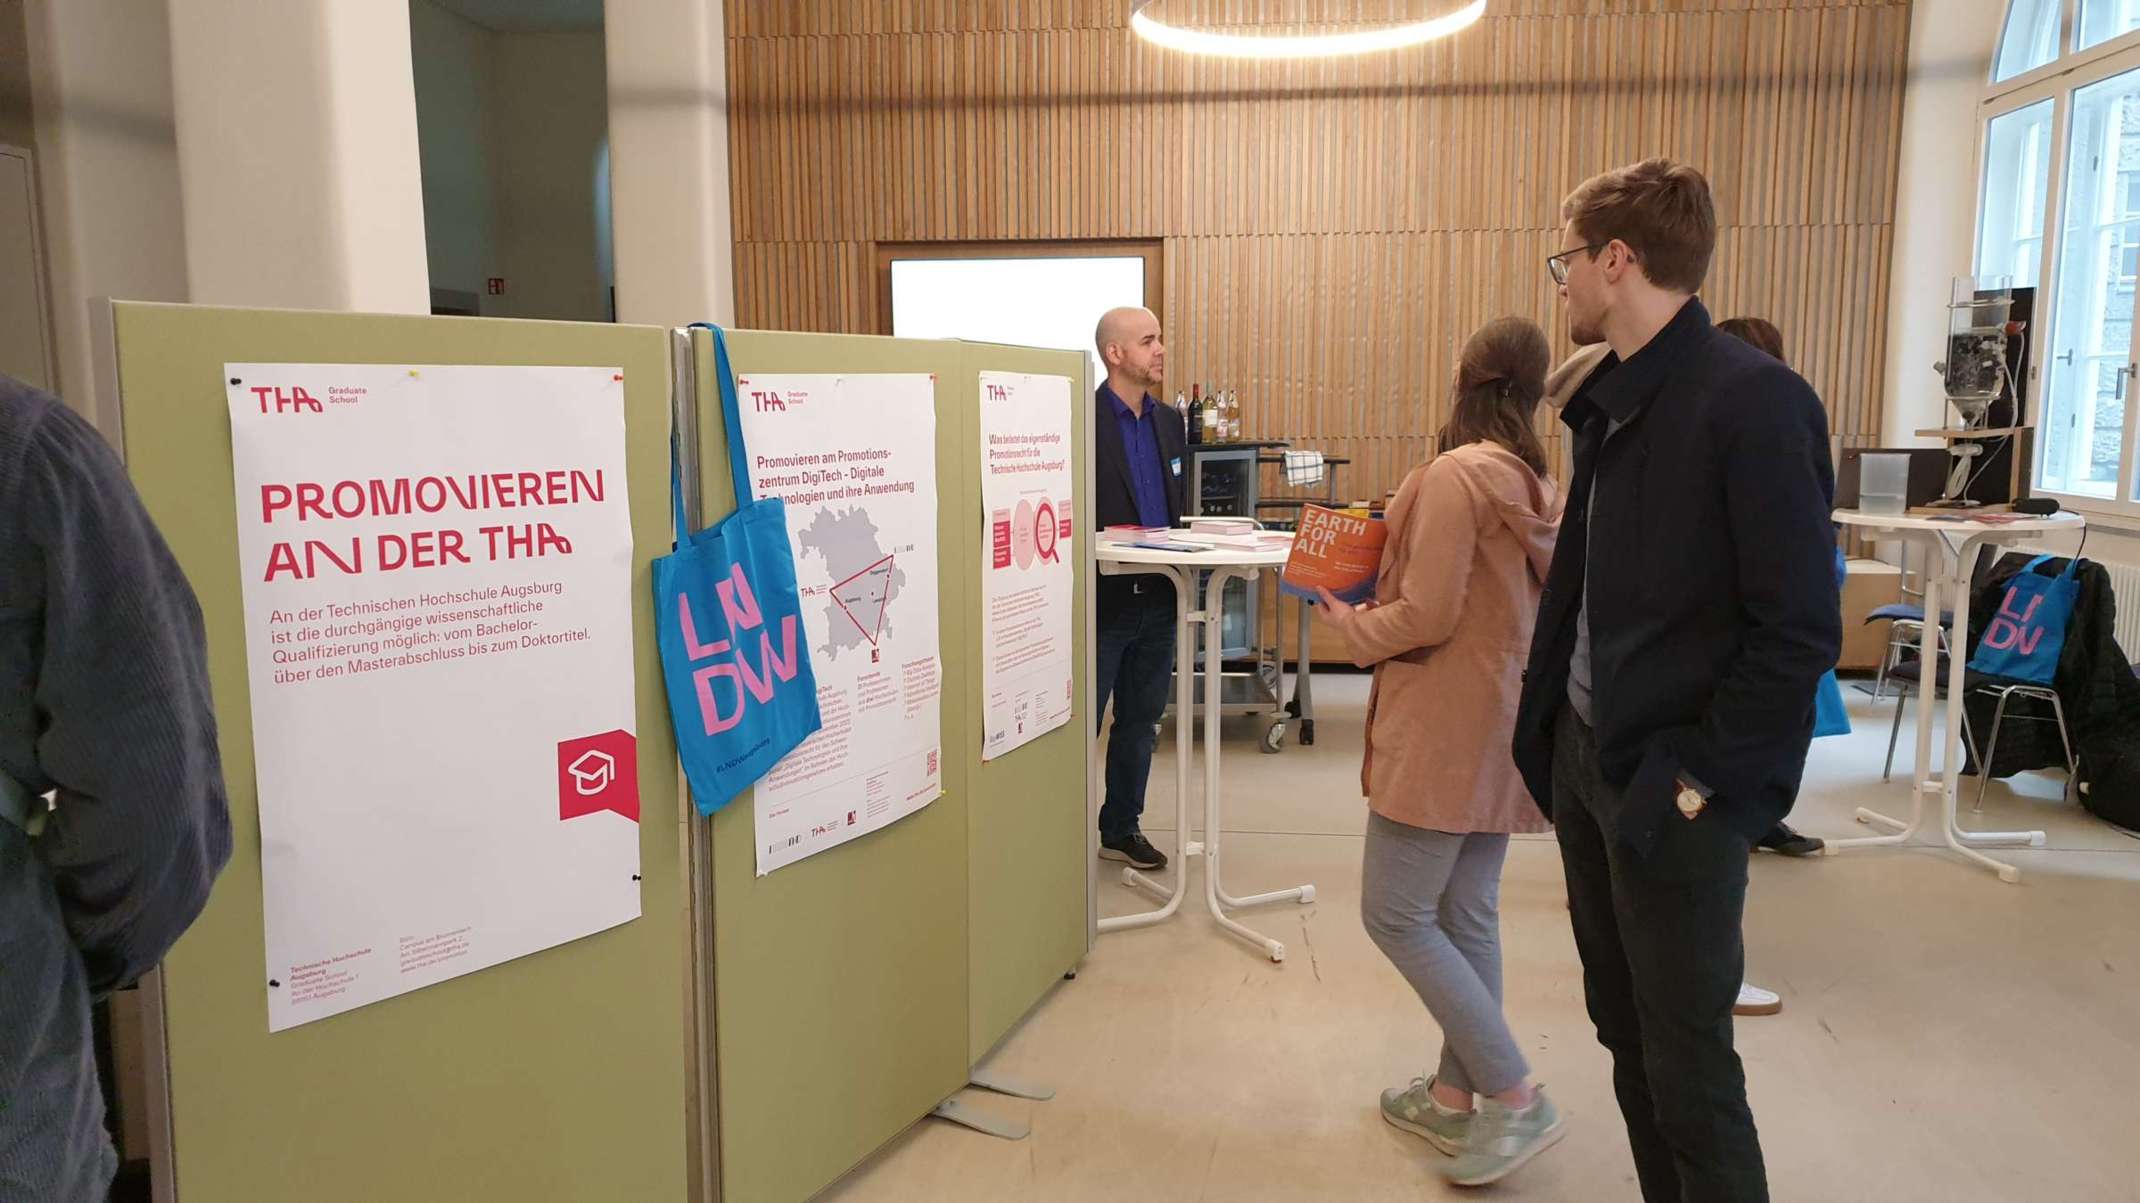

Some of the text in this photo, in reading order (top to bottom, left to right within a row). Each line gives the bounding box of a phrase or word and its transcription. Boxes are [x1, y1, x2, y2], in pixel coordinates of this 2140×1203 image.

[251, 386, 367, 413] THA Graduate
[329, 396, 358, 404] School
[751, 391, 786, 412] THA
[757, 448, 892, 469] Promovieren am Promotions-
[759, 474, 800, 489] zentrum
[802, 470, 842, 486] DigiTech
[850, 465, 885, 480] Digitale
[827, 486, 844, 500] und
[845, 485, 862, 498] ihre
[864, 479, 915, 496] Anwendung
[261, 469, 605, 523] PROMOVIEREN
[1300, 523, 1337, 545] FOR
[1304, 510, 1367, 536] EARTH
[264, 523, 573, 582] AN DER THA
[1295, 538, 1328, 558] ALL
[270, 581, 562, 624] An der Technischen Hochschule Augsburg
[271, 600, 543, 644] ist die durchgängige wissenschaftliche
[273, 620, 537, 664] Qualifizierung möglich: vom Bachelor-
[274, 627, 591, 684] über den Masterabschluss bis zum Doktortitel.
